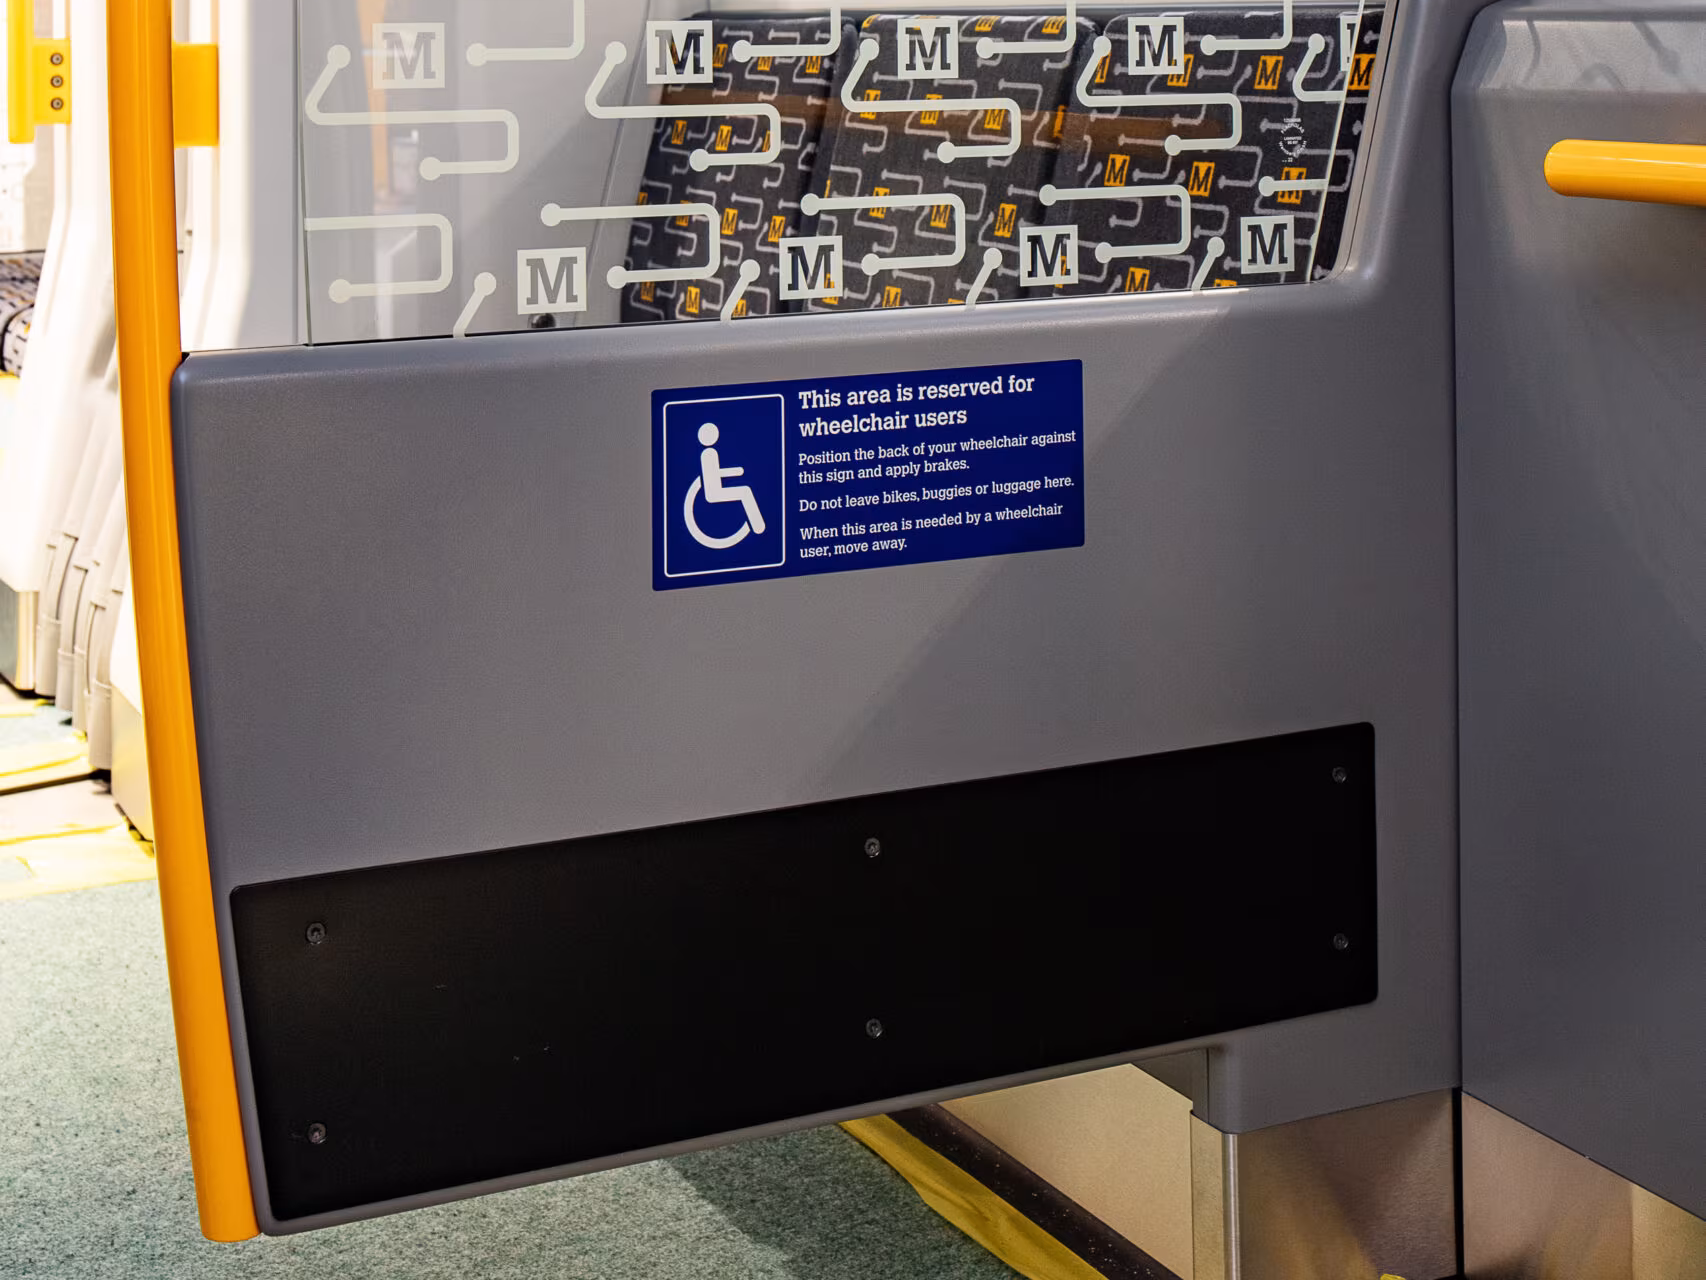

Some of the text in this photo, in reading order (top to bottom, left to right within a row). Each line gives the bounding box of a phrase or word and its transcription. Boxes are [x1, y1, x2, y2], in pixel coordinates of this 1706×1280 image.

[379, 28, 439, 82] M
[652, 26, 707, 78] M
[713, 44, 728, 67] M
[902, 24, 954, 74] M
[1132, 22, 1180, 69] M
[1257, 58, 1281, 88] M
[1351, 57, 1374, 86] M
[672, 121, 686, 144] M
[716, 126, 731, 150] M
[1106, 156, 1128, 185] M
[1190, 164, 1213, 195] M
[722, 209, 737, 234] M
[769, 217, 784, 241] M
[995, 204, 1016, 236] M
[1024, 230, 1074, 281] M
[1244, 220, 1291, 269] M
[523, 254, 581, 309] M
[784, 241, 838, 294] M
[1128, 269, 1148, 293] M
[687, 287, 699, 312] M
[798, 374, 1036, 410] This area is reserved for
[798, 409, 968, 438] wheelchair users
[798, 430, 1077, 466] Position the back of your wheelchair against
[798, 458, 970, 485] this sign and apply brakes.
[799, 476, 1075, 512] Do not leave bikes, buggies or luggage here.
[799, 504, 1064, 541] When this area is needed by a wheelchair
[799, 538, 908, 559] user, move away.
